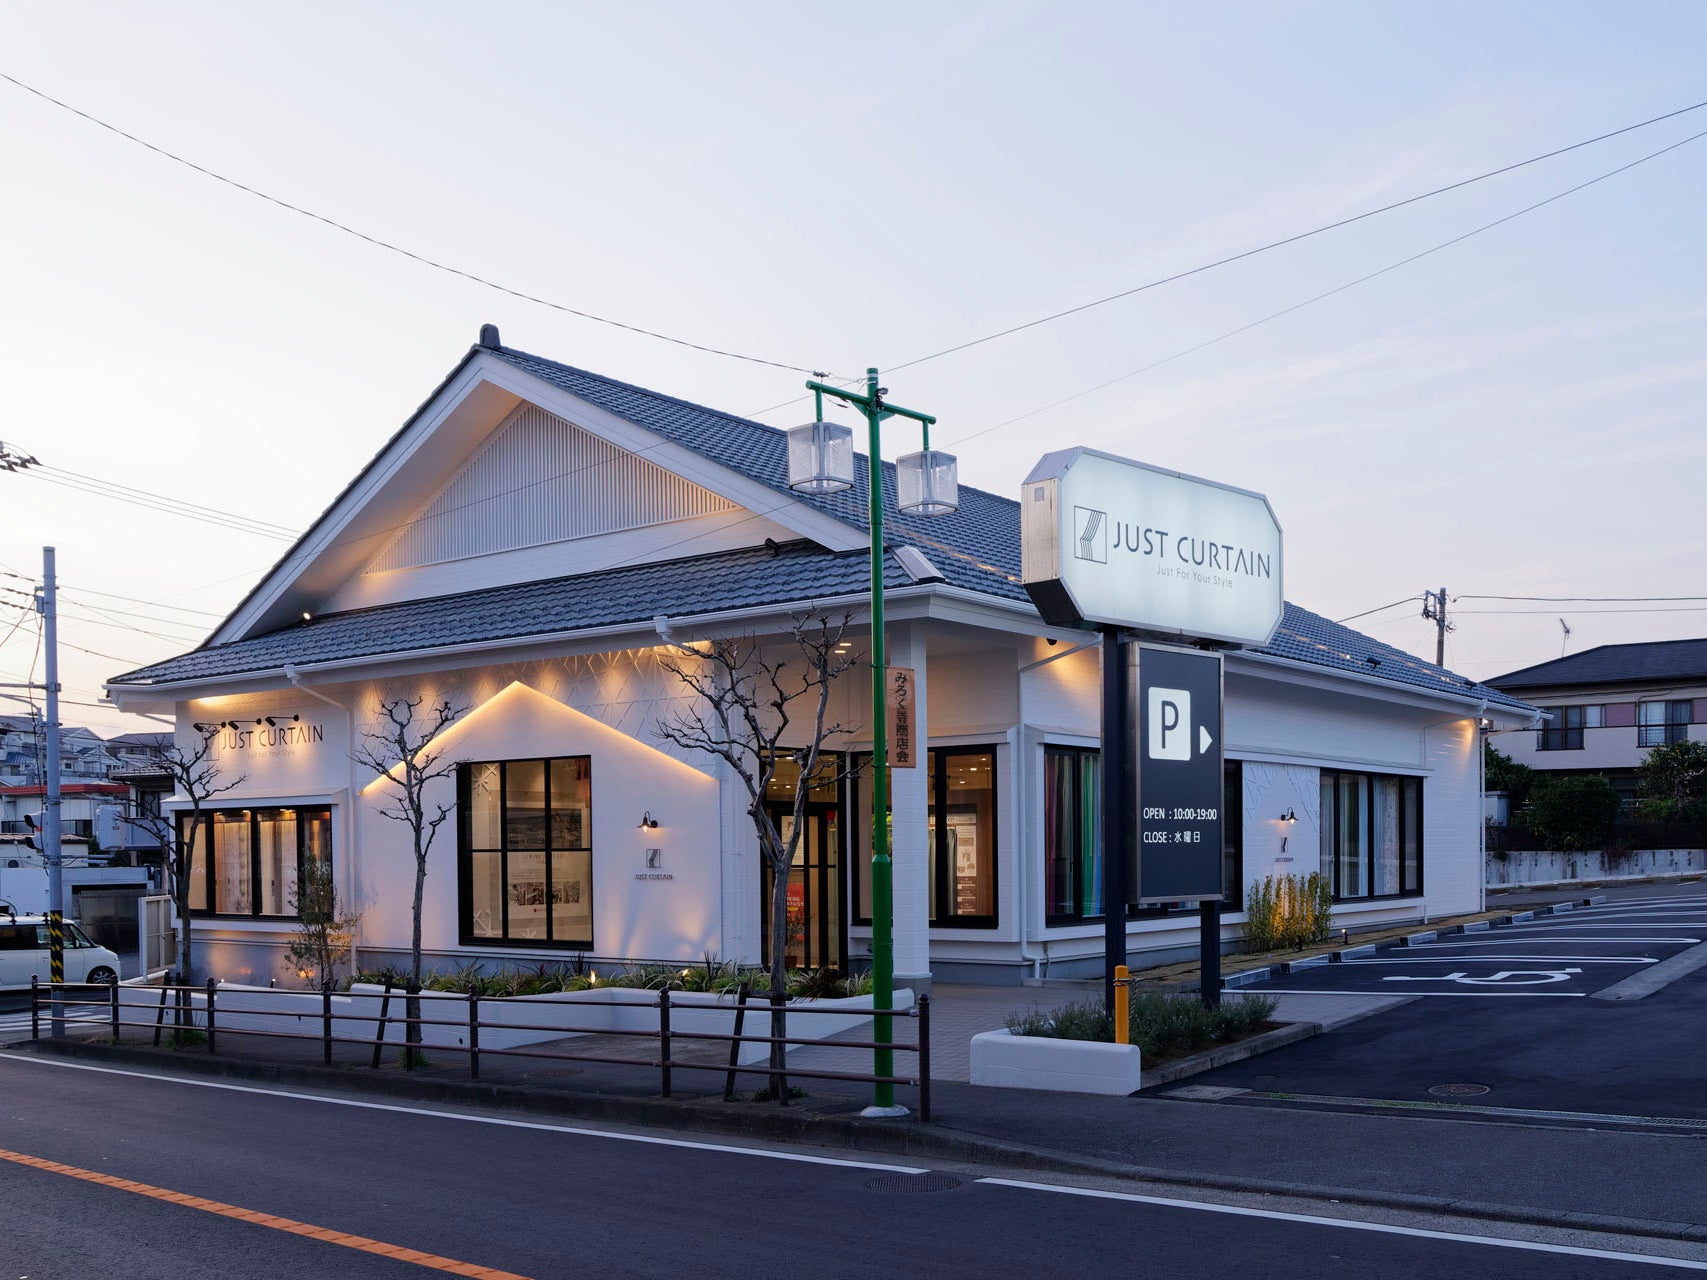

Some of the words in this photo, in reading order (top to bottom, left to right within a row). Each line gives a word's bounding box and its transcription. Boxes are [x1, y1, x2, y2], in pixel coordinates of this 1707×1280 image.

[1113, 521, 1169, 558] JUST
[1176, 536, 1271, 579] CURTAIN
[1156, 564, 1174, 577] Just
[1176, 567, 1190, 580] For
[1192, 570, 1211, 584] Your
[1213, 574, 1233, 589] Style
[222, 730, 254, 750] JUST
[258, 723, 324, 748] CURTAIN
[1161, 700, 1180, 750] P
[1143, 807, 1166, 820] OPEN
[1173, 807, 1218, 820] 10:00-19:00
[1173, 830, 1201, 843] 水曜日
